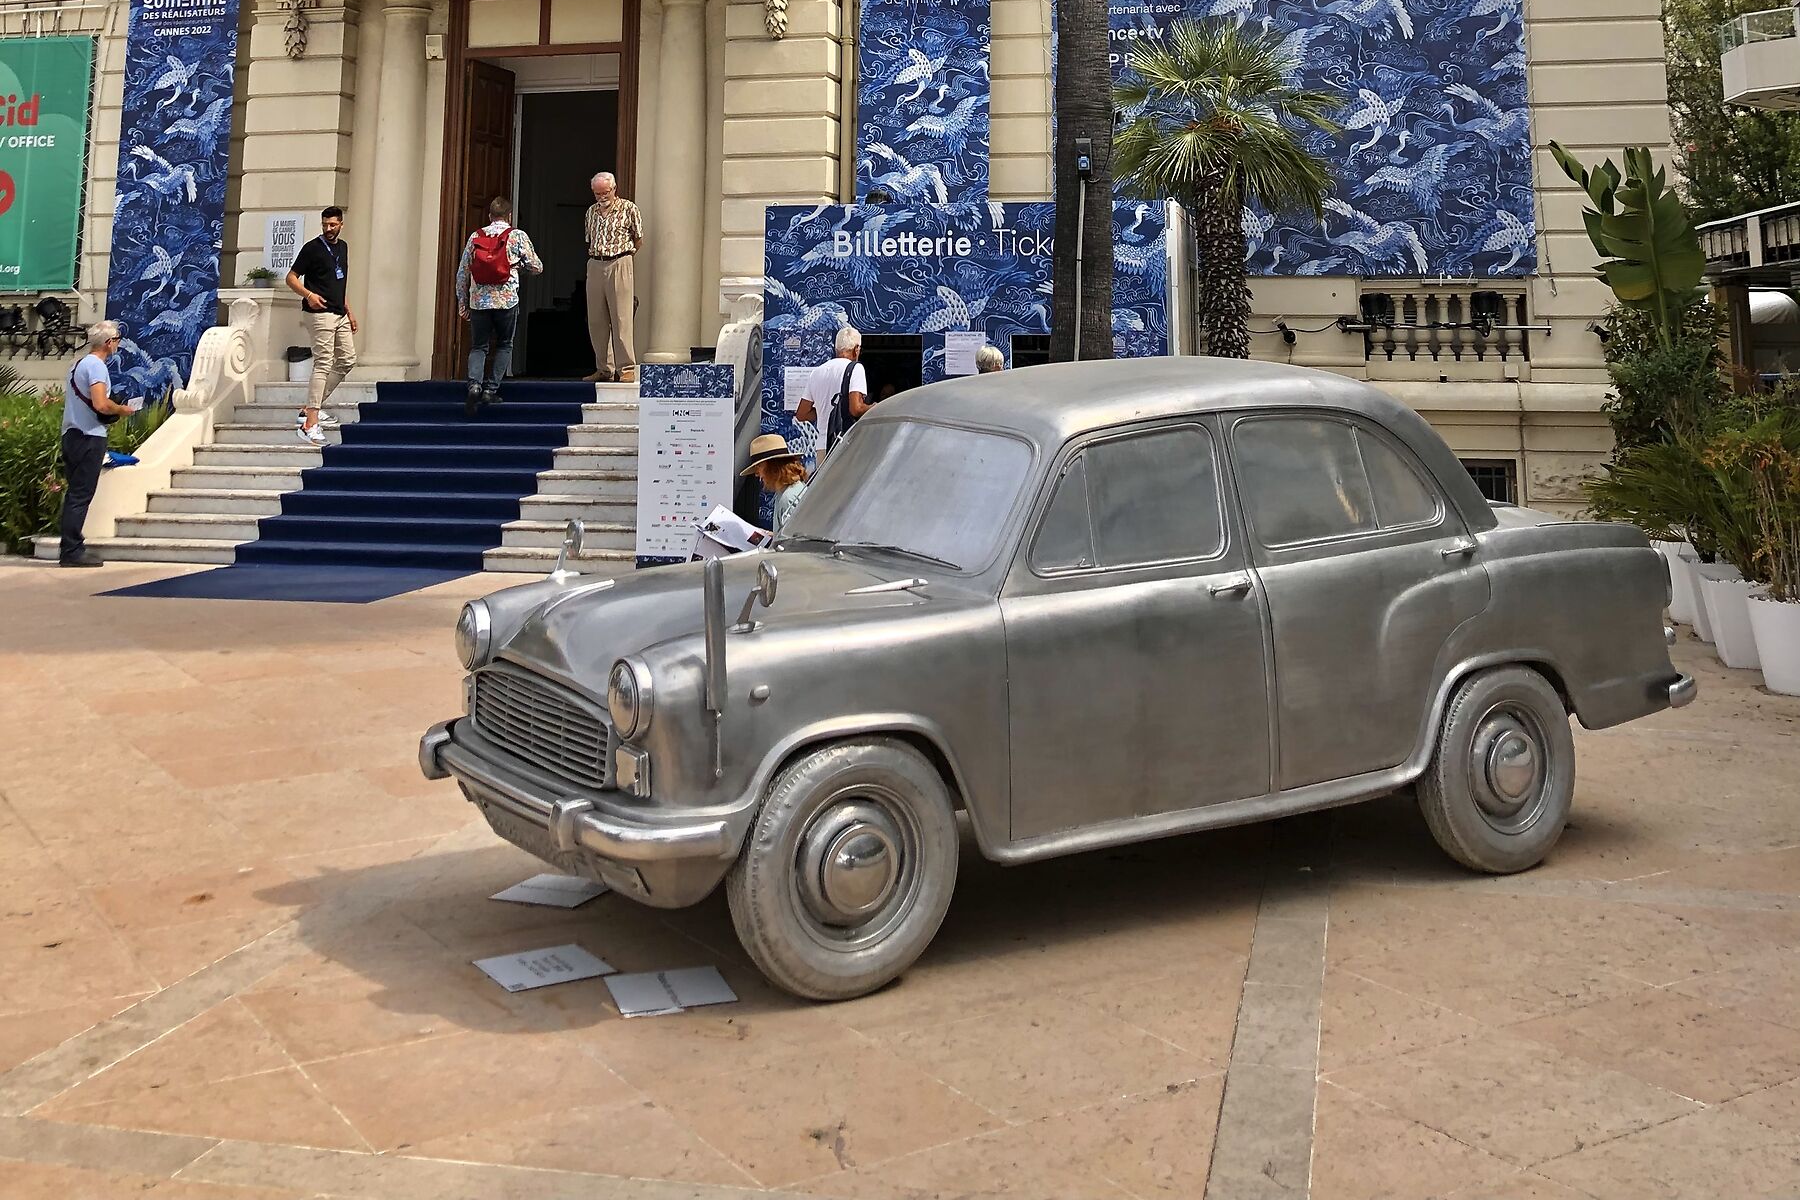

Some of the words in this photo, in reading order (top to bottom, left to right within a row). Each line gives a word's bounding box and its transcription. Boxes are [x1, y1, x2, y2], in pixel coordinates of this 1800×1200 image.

[143, 11, 160, 20] DES
[162, 7, 226, 19] RÉALISATEURS
[1108, 3, 1154, 15] rtenariat
[1155, 4, 1181, 13] avec
[154, 26, 190, 37] CANNES
[191, 25, 212, 35] 2022
[8, 135, 56, 148] OFFICE
[272, 233, 295, 245] VOUS
[833, 229, 972, 258] Billetterie
[992, 228, 1055, 256] Tick
